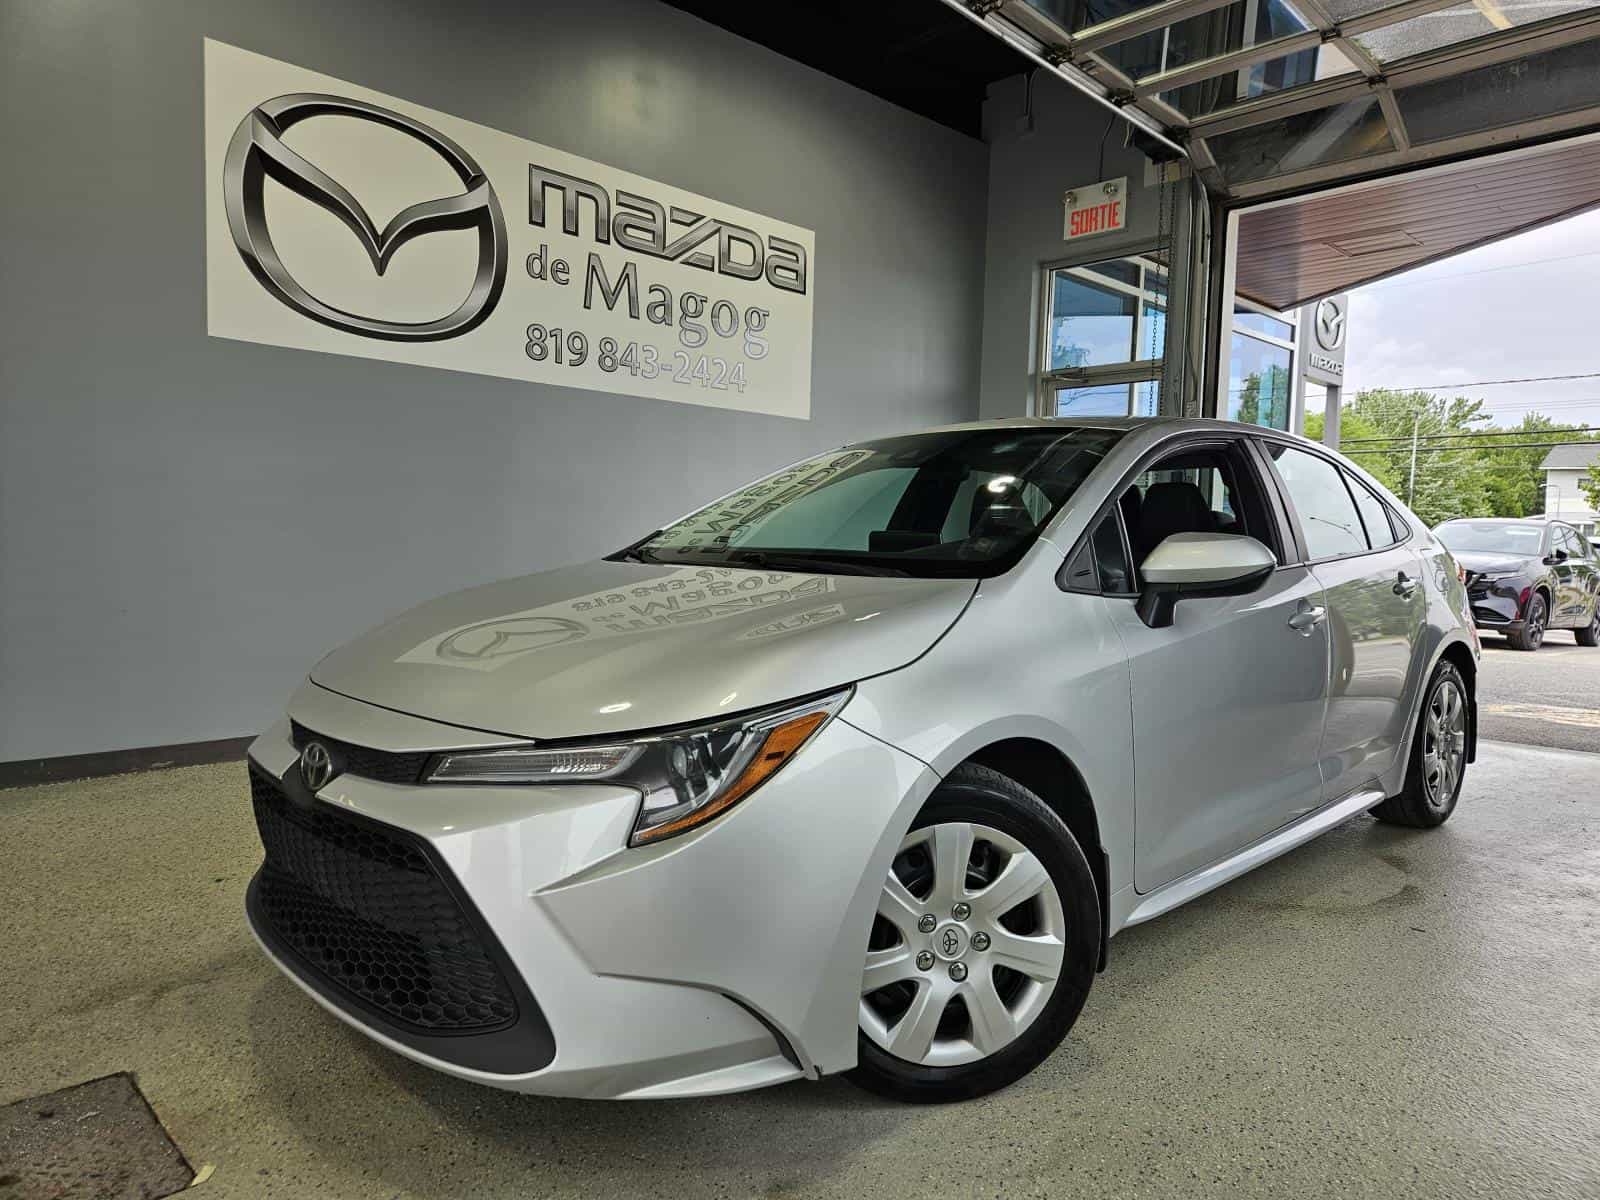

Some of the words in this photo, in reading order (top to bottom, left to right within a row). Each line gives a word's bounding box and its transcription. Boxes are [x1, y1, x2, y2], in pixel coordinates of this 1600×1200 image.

[1069, 200, 1121, 237] SORTIE
[525, 243, 571, 286] de
[583, 251, 770, 361] Magog
[525, 322, 589, 367] 819
[597, 336, 748, 394] 843-2424
